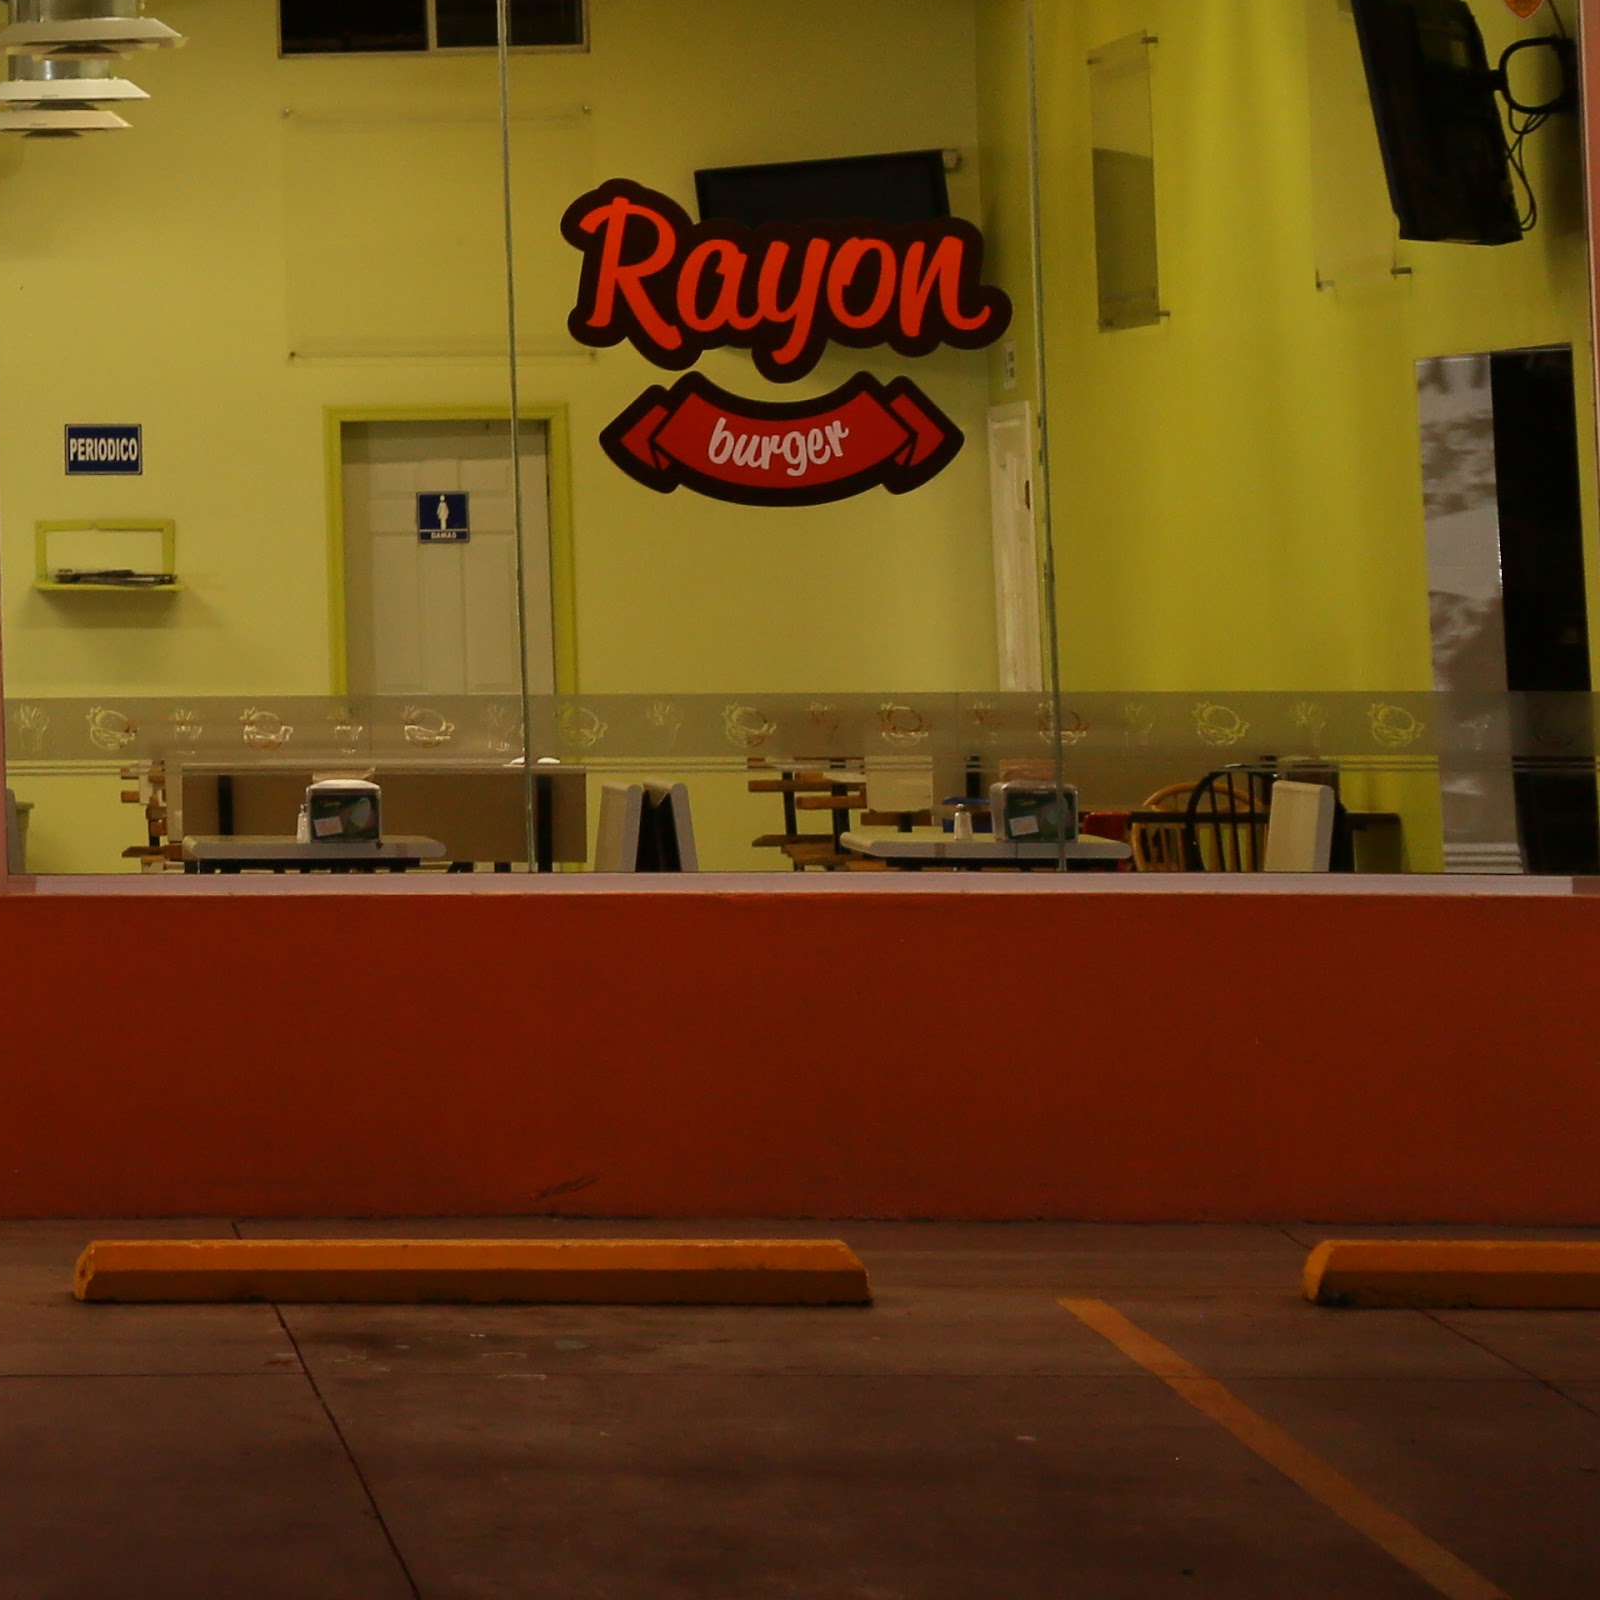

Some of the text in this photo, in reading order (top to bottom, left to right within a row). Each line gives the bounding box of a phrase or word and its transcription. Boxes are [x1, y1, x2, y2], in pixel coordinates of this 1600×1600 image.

[579, 196, 991, 364] Rayon
[69, 438, 138, 461] PERIODICO
[708, 418, 849, 476] burger
